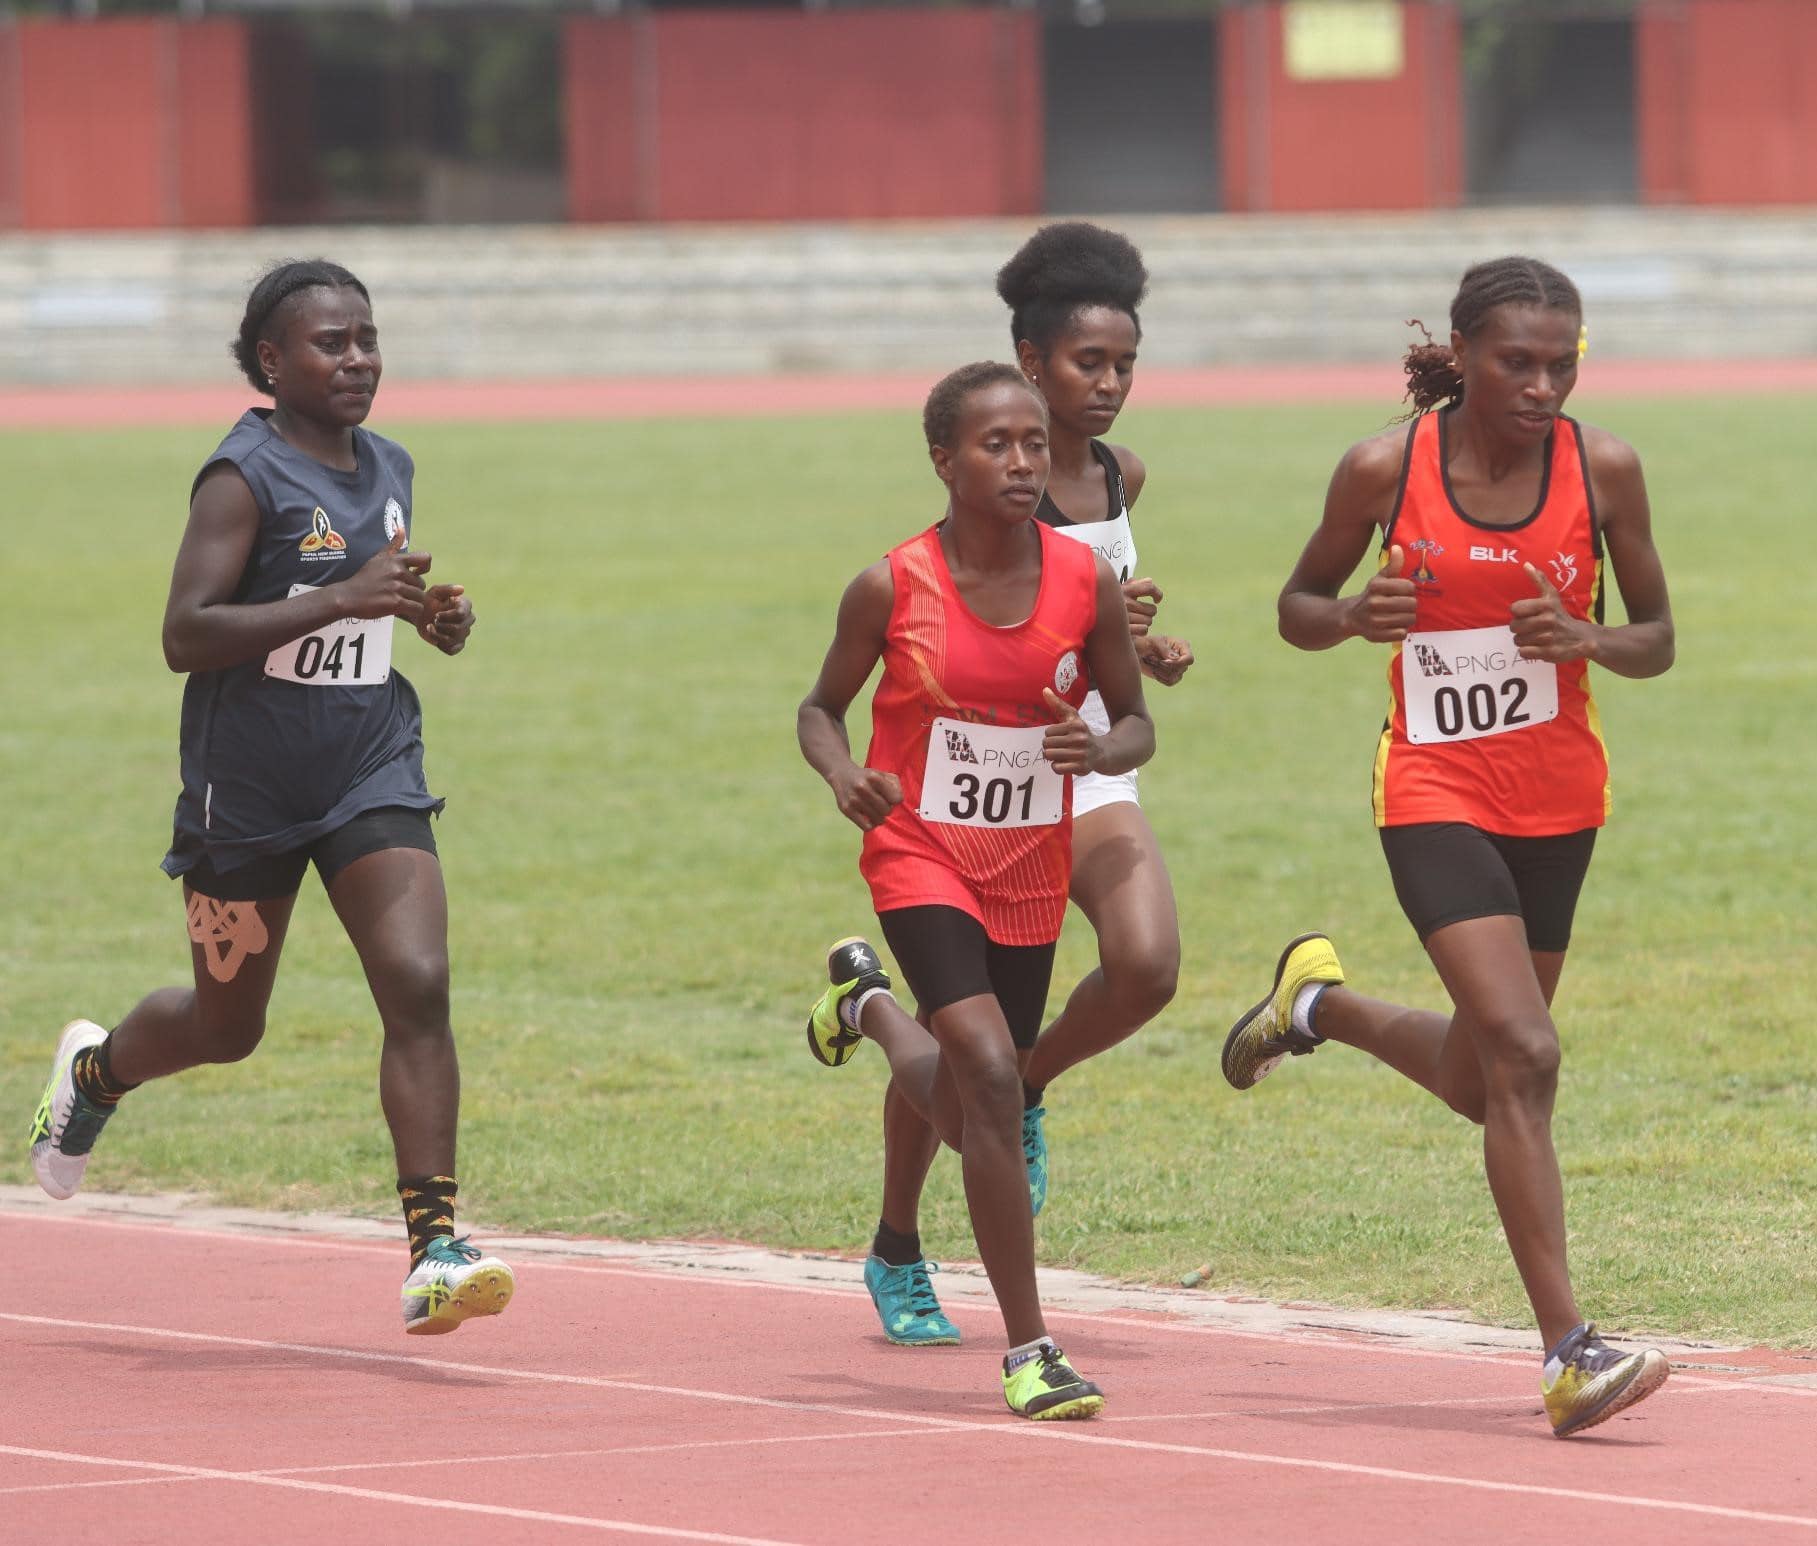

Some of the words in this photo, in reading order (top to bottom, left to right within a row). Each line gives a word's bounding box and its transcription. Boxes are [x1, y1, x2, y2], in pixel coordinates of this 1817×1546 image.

[1469, 545, 1519, 564] BLK
[294, 633, 365, 679] 041
[1455, 651, 1507, 675] PNG
[1434, 677, 1530, 736] 002
[982, 748, 1030, 769] PNG
[949, 772, 1035, 824] 301
